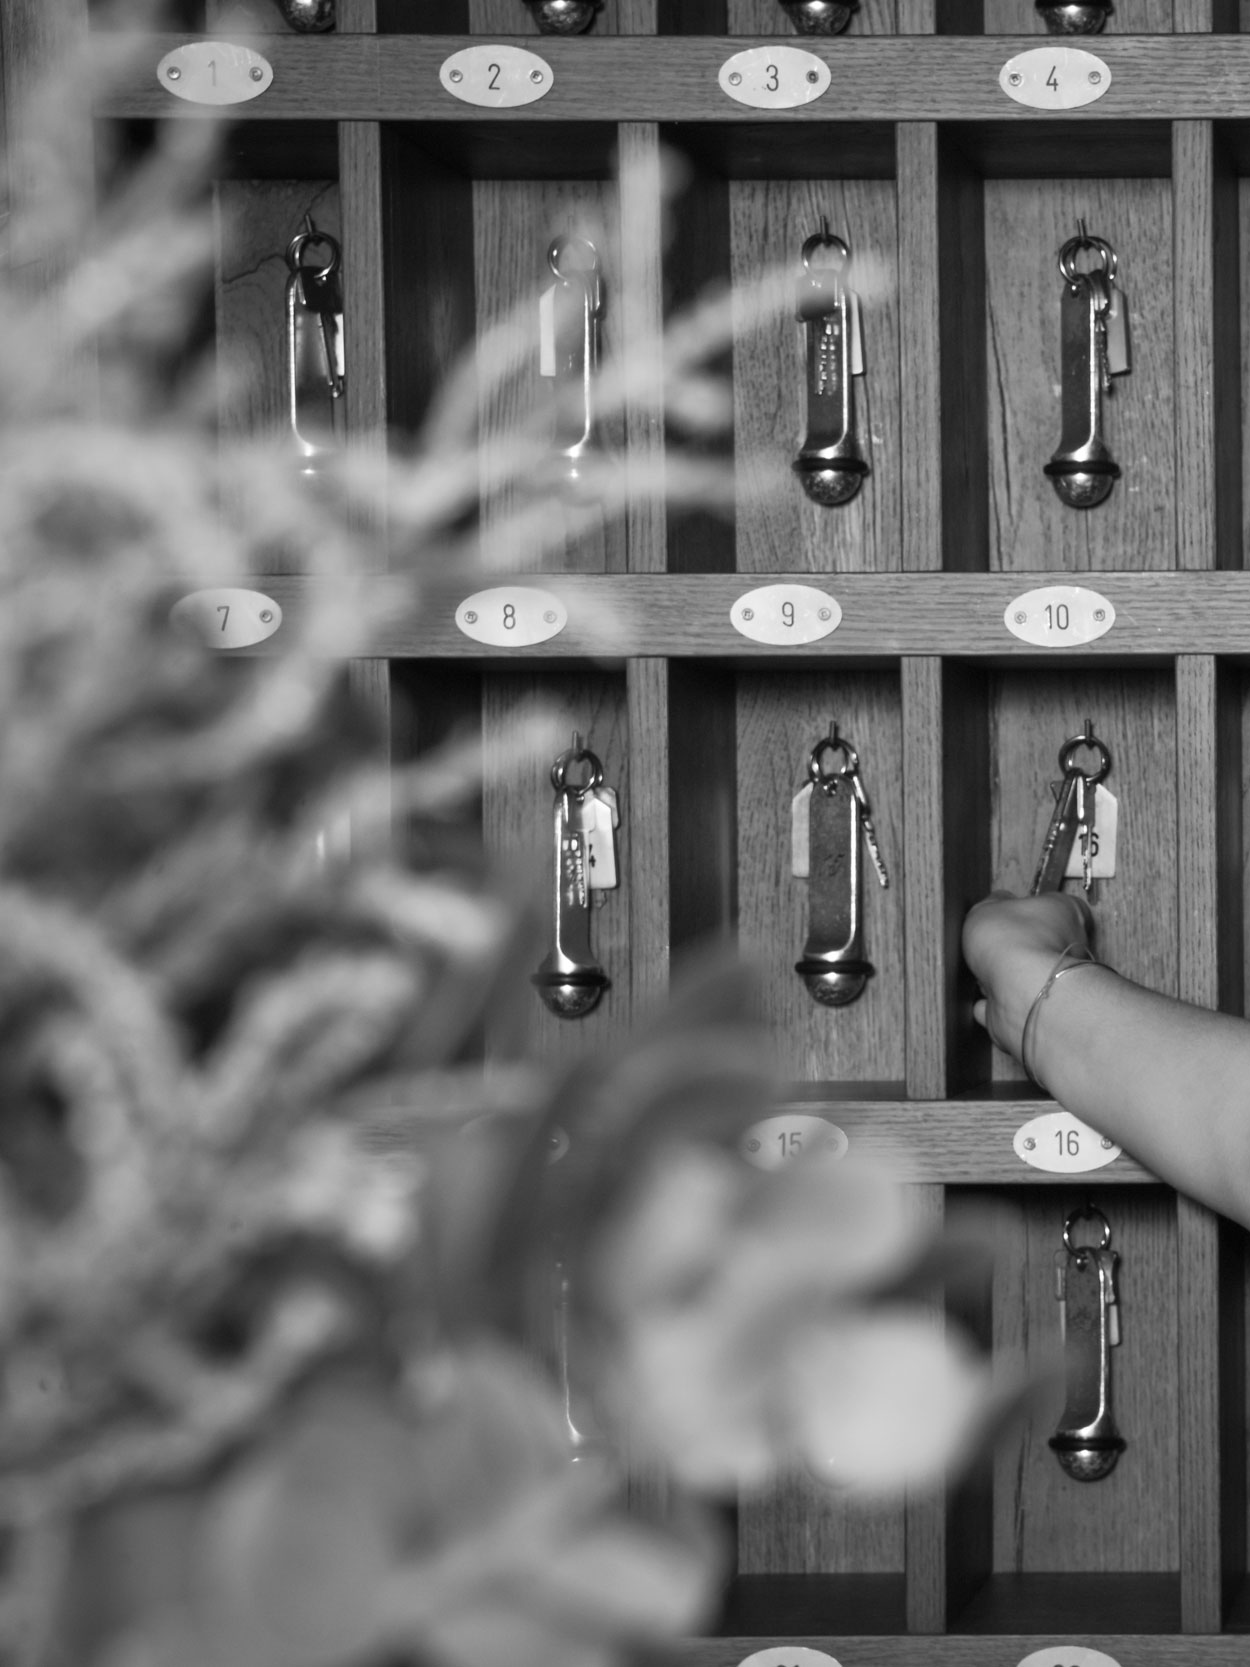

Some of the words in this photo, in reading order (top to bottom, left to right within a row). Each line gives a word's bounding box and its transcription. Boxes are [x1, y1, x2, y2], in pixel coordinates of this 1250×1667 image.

[207, 59, 217, 86] 1
[487, 63, 501, 91] 2
[765, 64, 780, 92] 3
[1045, 65, 1059, 92] 4
[216, 605, 231, 632] 7
[502, 603, 516, 630] 8
[781, 601, 795, 628] 9
[1044, 603, 1070, 631] 10
[777, 1131, 804, 1157] 15
[1055, 1130, 1080, 1157] 16
